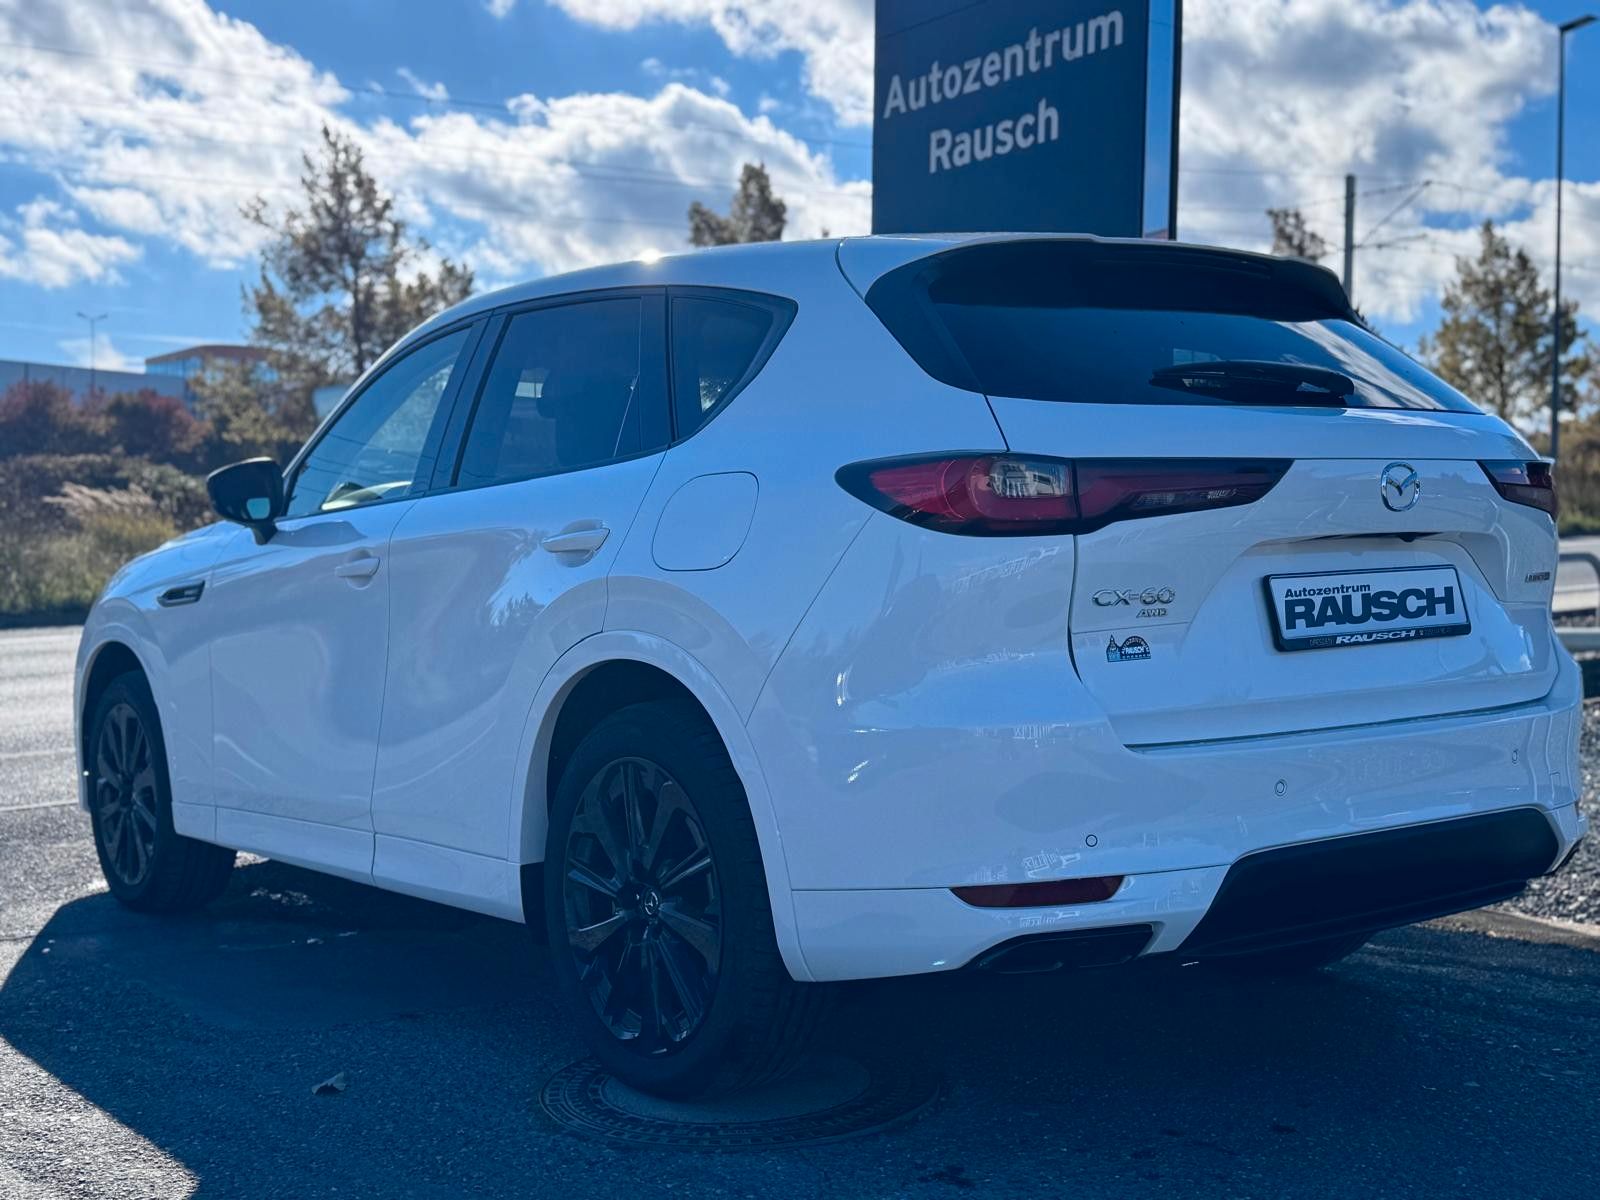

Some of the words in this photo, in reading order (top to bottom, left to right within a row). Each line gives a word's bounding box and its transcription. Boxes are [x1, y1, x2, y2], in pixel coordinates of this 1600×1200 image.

[883, 10, 1124, 119] Autozentrum
[929, 97, 1059, 173] Rausch
[1092, 586, 1175, 606] CX-60
[1285, 584, 1371, 598] Autozentrum
[1136, 608, 1168, 618] AWD
[1285, 586, 1455, 630] RAUSCH
[1336, 630, 1416, 645] RAUSCH
